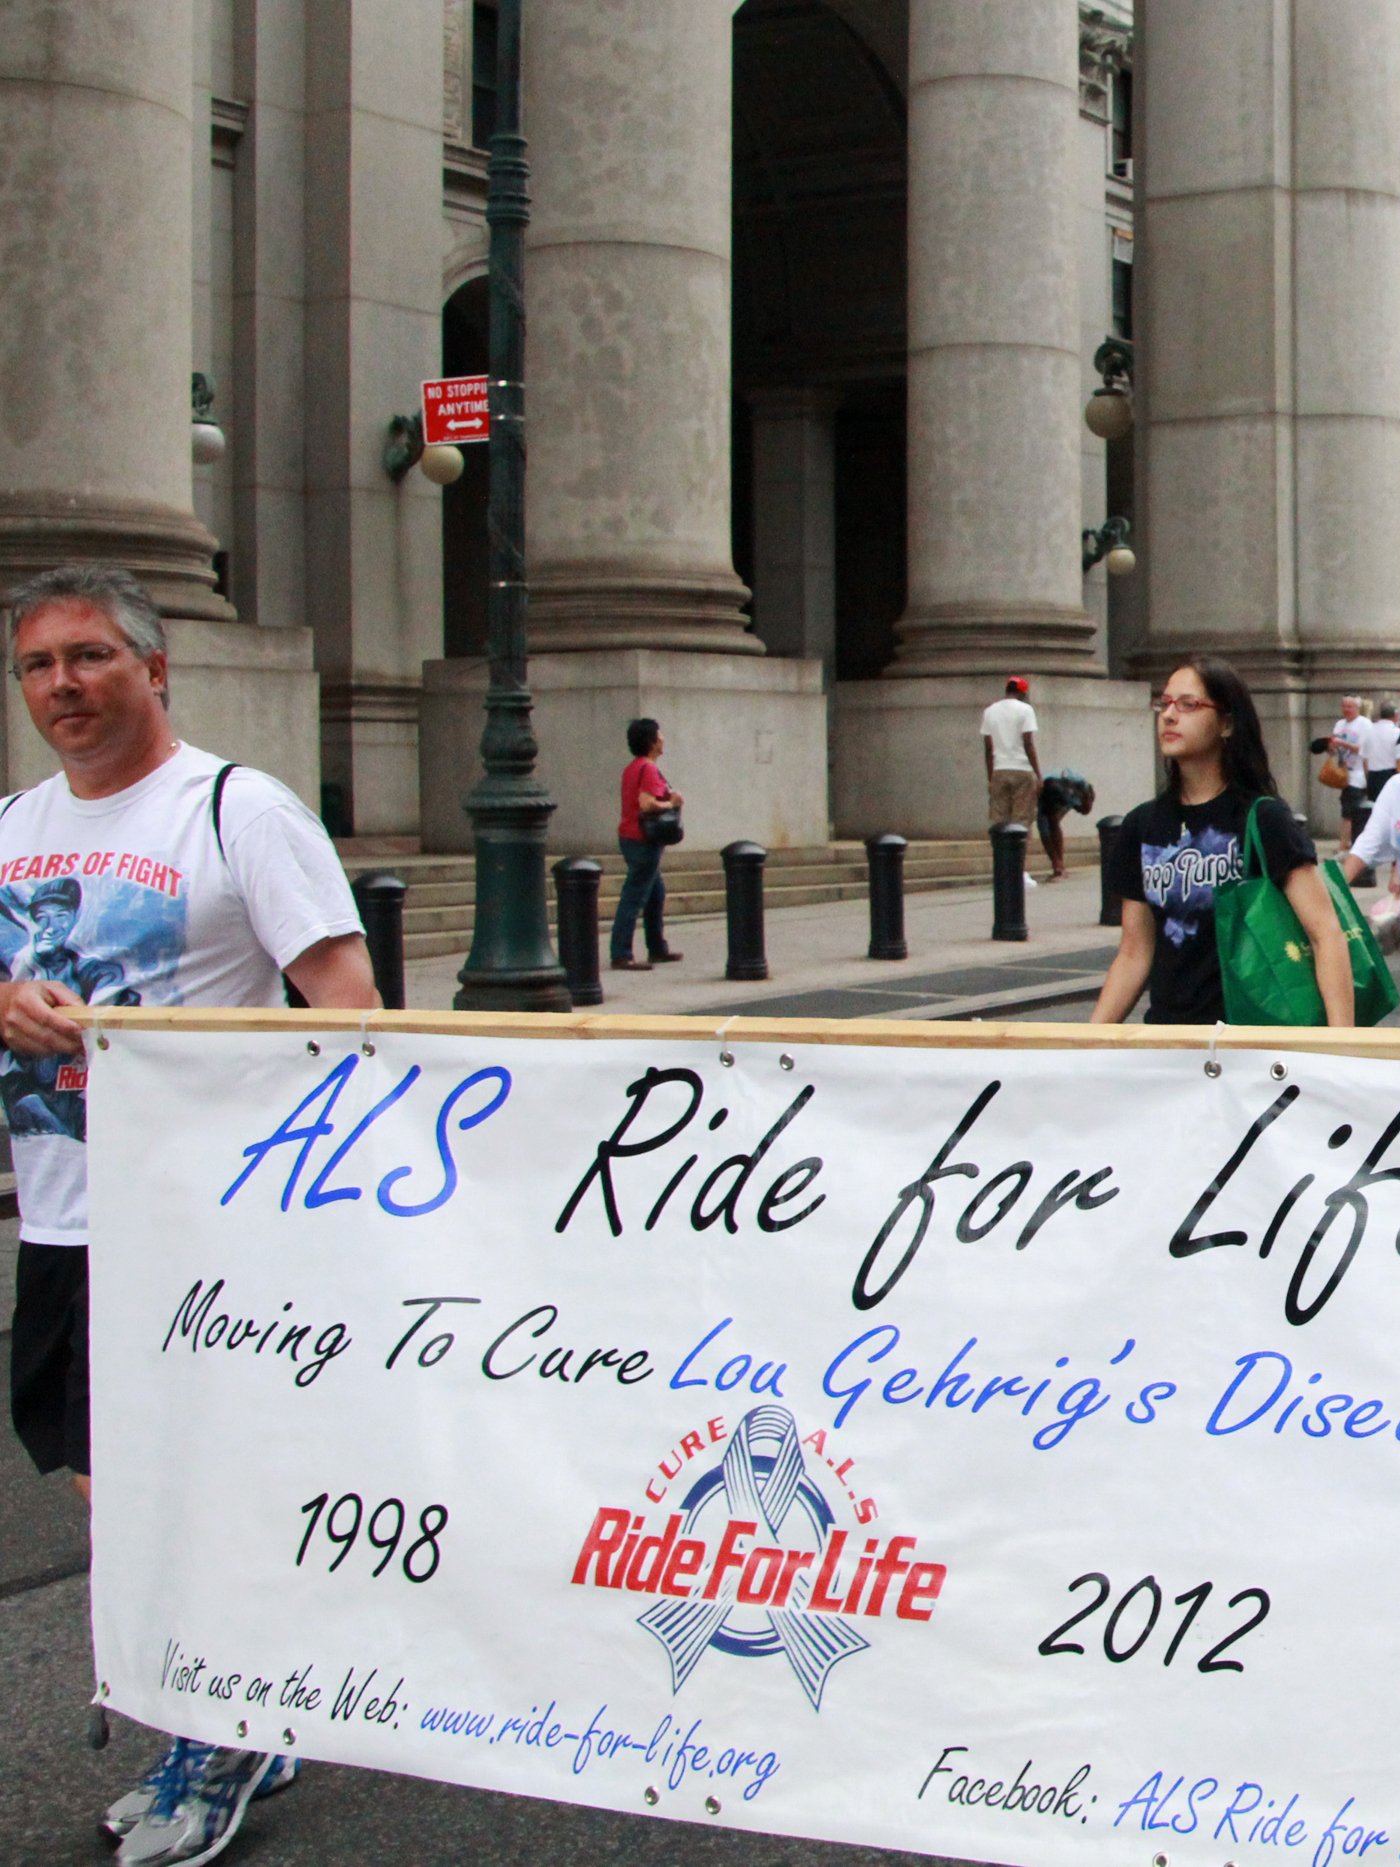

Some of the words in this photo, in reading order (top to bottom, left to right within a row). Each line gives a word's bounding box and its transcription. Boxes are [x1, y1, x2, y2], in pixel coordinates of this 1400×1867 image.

[427, 386, 443, 399] NO
[438, 399, 489, 416] ANYTIME
[83, 851, 116, 877] OF
[116, 852, 184, 898] FIGHT
[219, 1053, 512, 1218] ALS
[555, 1067, 826, 1238] Ride
[852, 1080, 1119, 1311] for
[162, 1279, 352, 1387] Moving
[384, 1298, 481, 1369] To
[482, 1305, 654, 1385] Cure
[669, 1317, 788, 1398] Lou
[822, 1324, 1177, 1451] Gehrig's
[645, 1416, 728, 1504] CURE
[296, 1493, 448, 1584] 1998
[571, 1507, 707, 1598] Ride
[701, 1520, 817, 1607] For
[806, 1529, 948, 1622] Life
[1038, 1573, 1271, 1675] 2012
[162, 1640, 207, 1694] Visit
[207, 1673, 242, 1701] us
[245, 1677, 273, 1707] on
[280, 1664, 321, 1711] the
[331, 1667, 409, 1730] Web:
[420, 1701, 780, 1802] www.ride-for-life.org
[918, 1747, 1098, 1826] Facebook:
[1112, 1771, 1219, 1835] ALS
[1221, 1782, 1309, 1848] Ride
[1311, 1797, 1391, 1867] for
